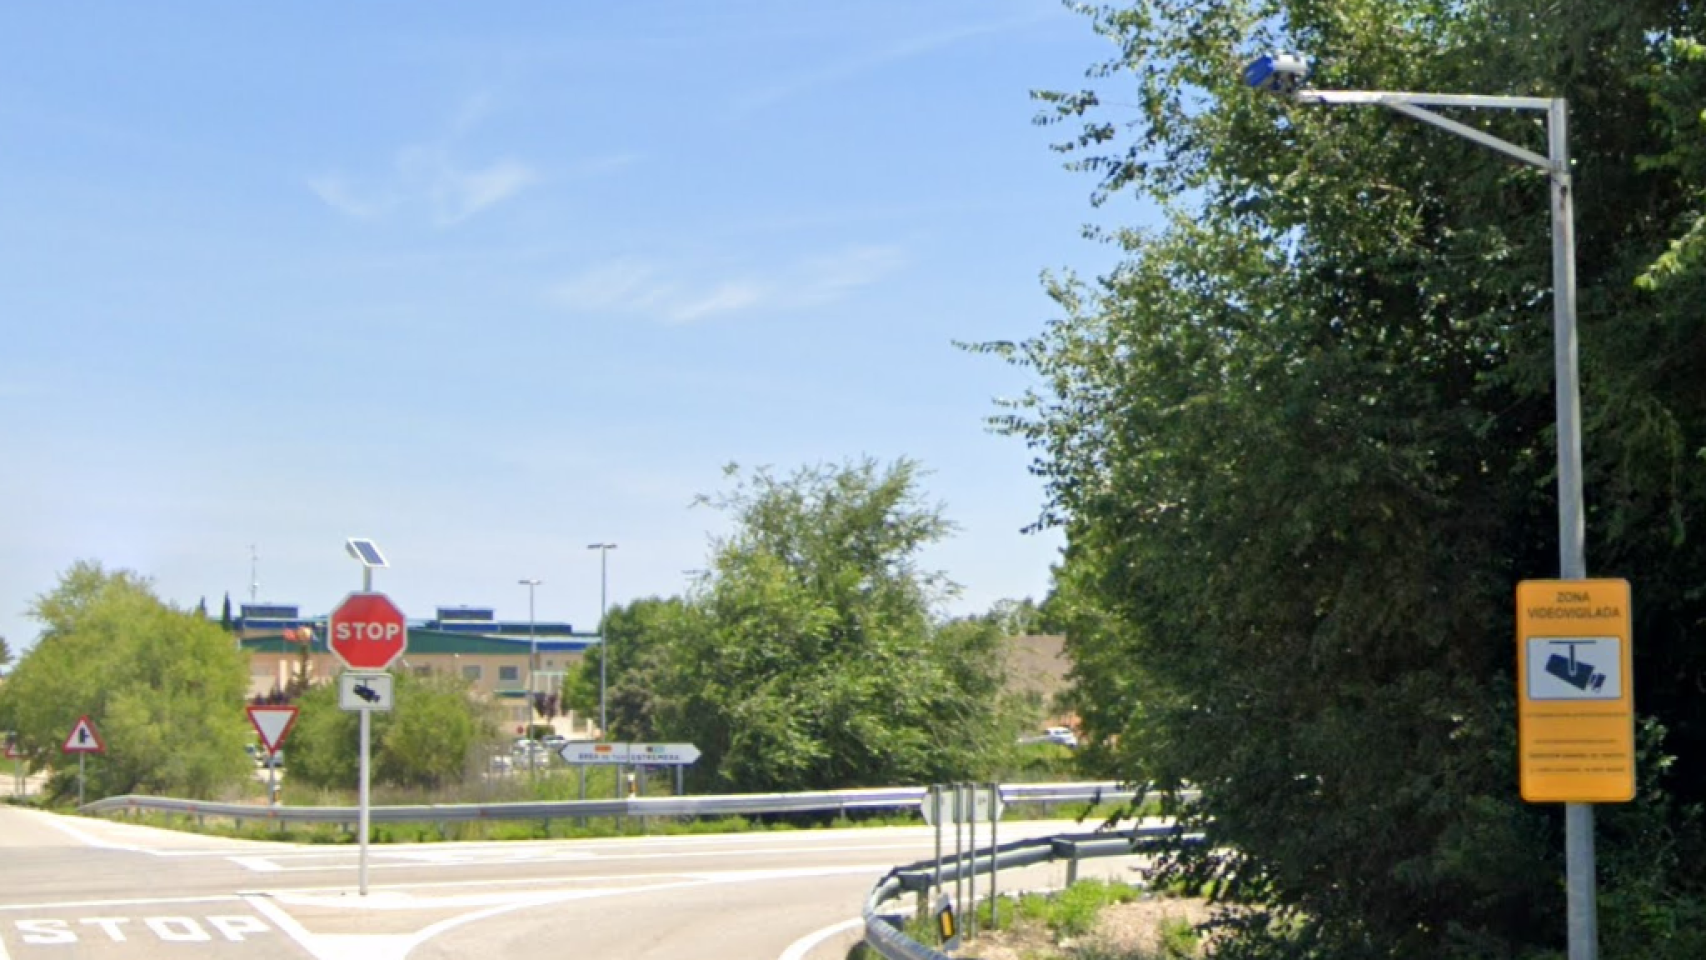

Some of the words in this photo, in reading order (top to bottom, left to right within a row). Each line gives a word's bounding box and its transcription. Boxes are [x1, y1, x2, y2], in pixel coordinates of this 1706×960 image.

[1556, 591, 1591, 602] ZONA
[1527, 605, 1621, 619] VIDEOVIGILADA
[336, 622, 400, 640] STOP
[14, 915, 271, 944] STOP
